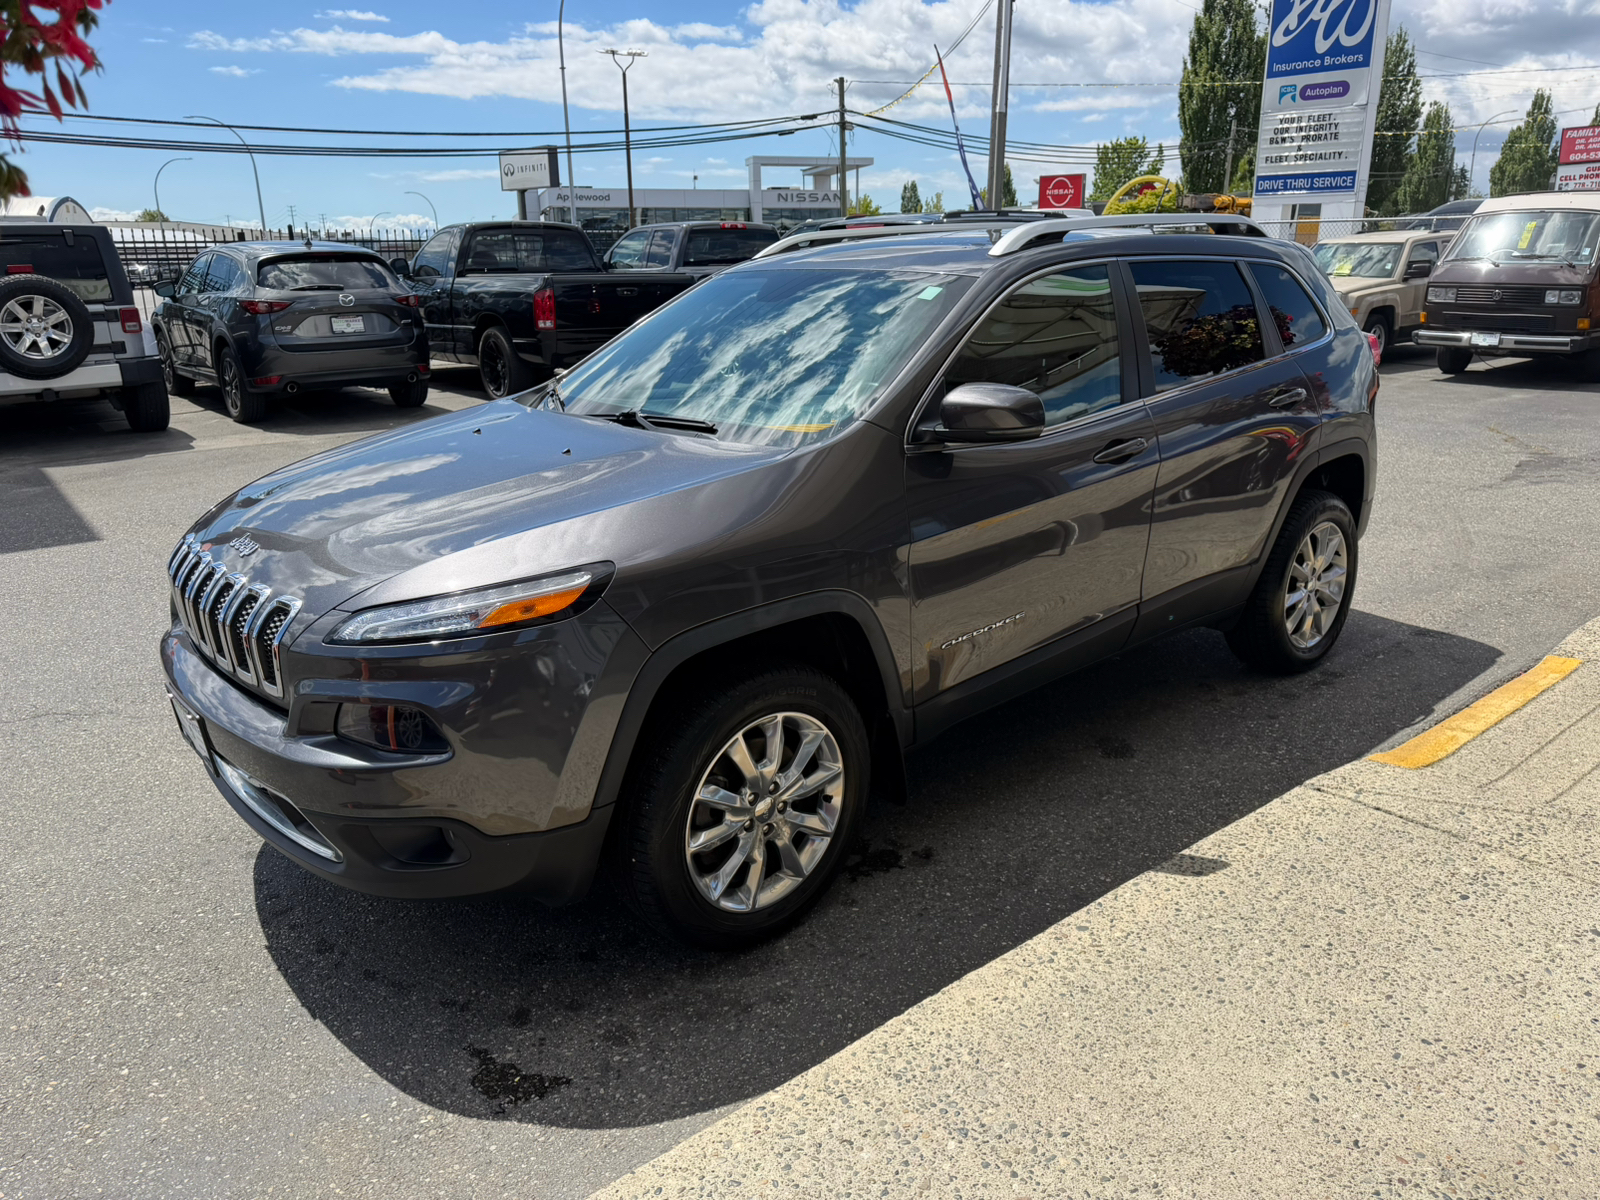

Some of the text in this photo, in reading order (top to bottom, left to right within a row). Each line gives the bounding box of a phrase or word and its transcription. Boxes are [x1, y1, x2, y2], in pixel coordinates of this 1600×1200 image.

[1272, 53, 1364, 72] Insurance Brokers
[1305, 86, 1343, 97] Autoplan
[1279, 113, 1337, 125] YOUR FLEET.
[1273, 122, 1340, 136] OUR INTEGRITY
[1566, 128, 1600, 138] FAMILY
[1269, 132, 1340, 145] B&W'S PRORATE
[1296, 144, 1302, 152] &
[1264, 151, 1348, 164] FLEET SPECIALITY.
[517, 163, 547, 174] INFINITI
[1258, 176, 1354, 190] DRIVE THRU SERVICE
[556, 193, 611, 202] Aplewood
[941, 611, 1026, 650] CHEROKEE
